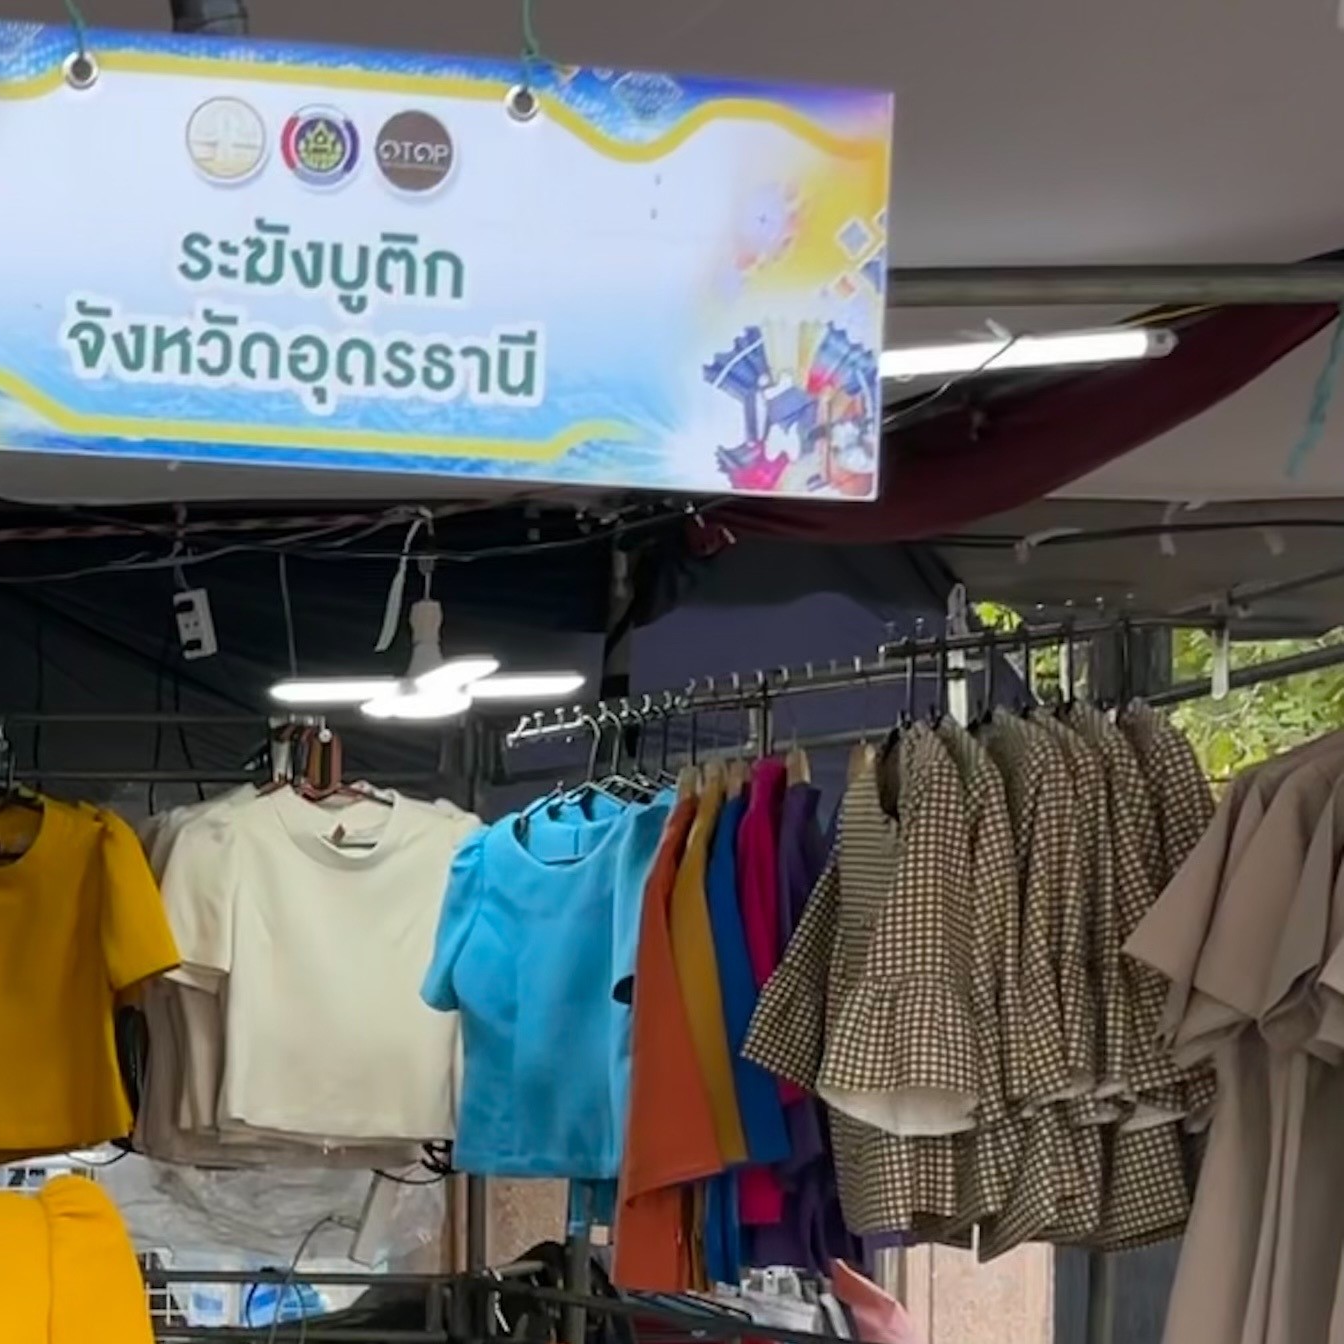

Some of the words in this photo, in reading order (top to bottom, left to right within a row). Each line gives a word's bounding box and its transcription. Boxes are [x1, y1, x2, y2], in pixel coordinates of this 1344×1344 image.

[378, 139, 450, 164] OTOP
[177, 217, 465, 315] ระฆังบูติก
[67, 299, 538, 405] จังหวัดอุดรธานี
